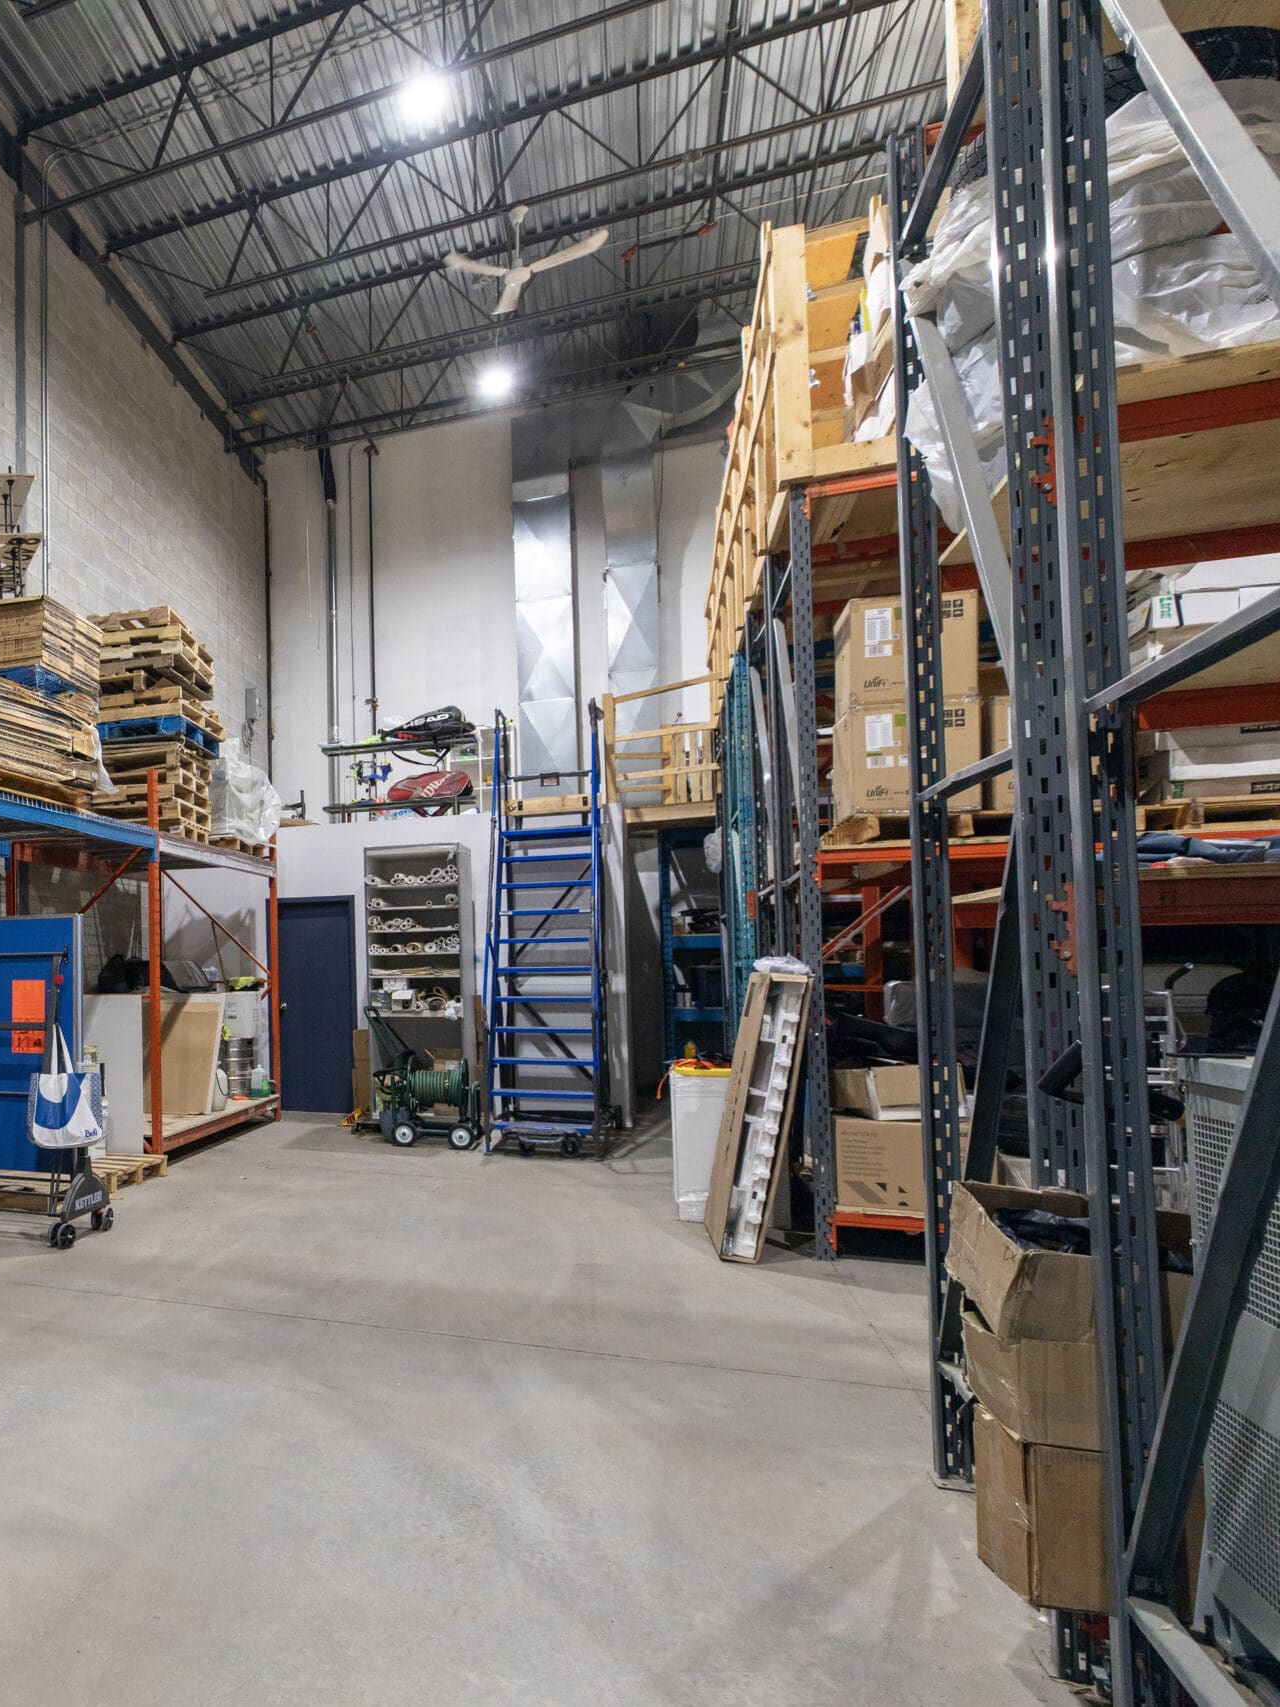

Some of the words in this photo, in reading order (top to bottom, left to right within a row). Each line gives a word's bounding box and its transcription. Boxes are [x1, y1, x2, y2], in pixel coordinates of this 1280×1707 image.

[866, 787, 888, 798] UniFi
[84, 1129, 98, 1138] Bell
[75, 1190, 103, 1211] KETTLER
